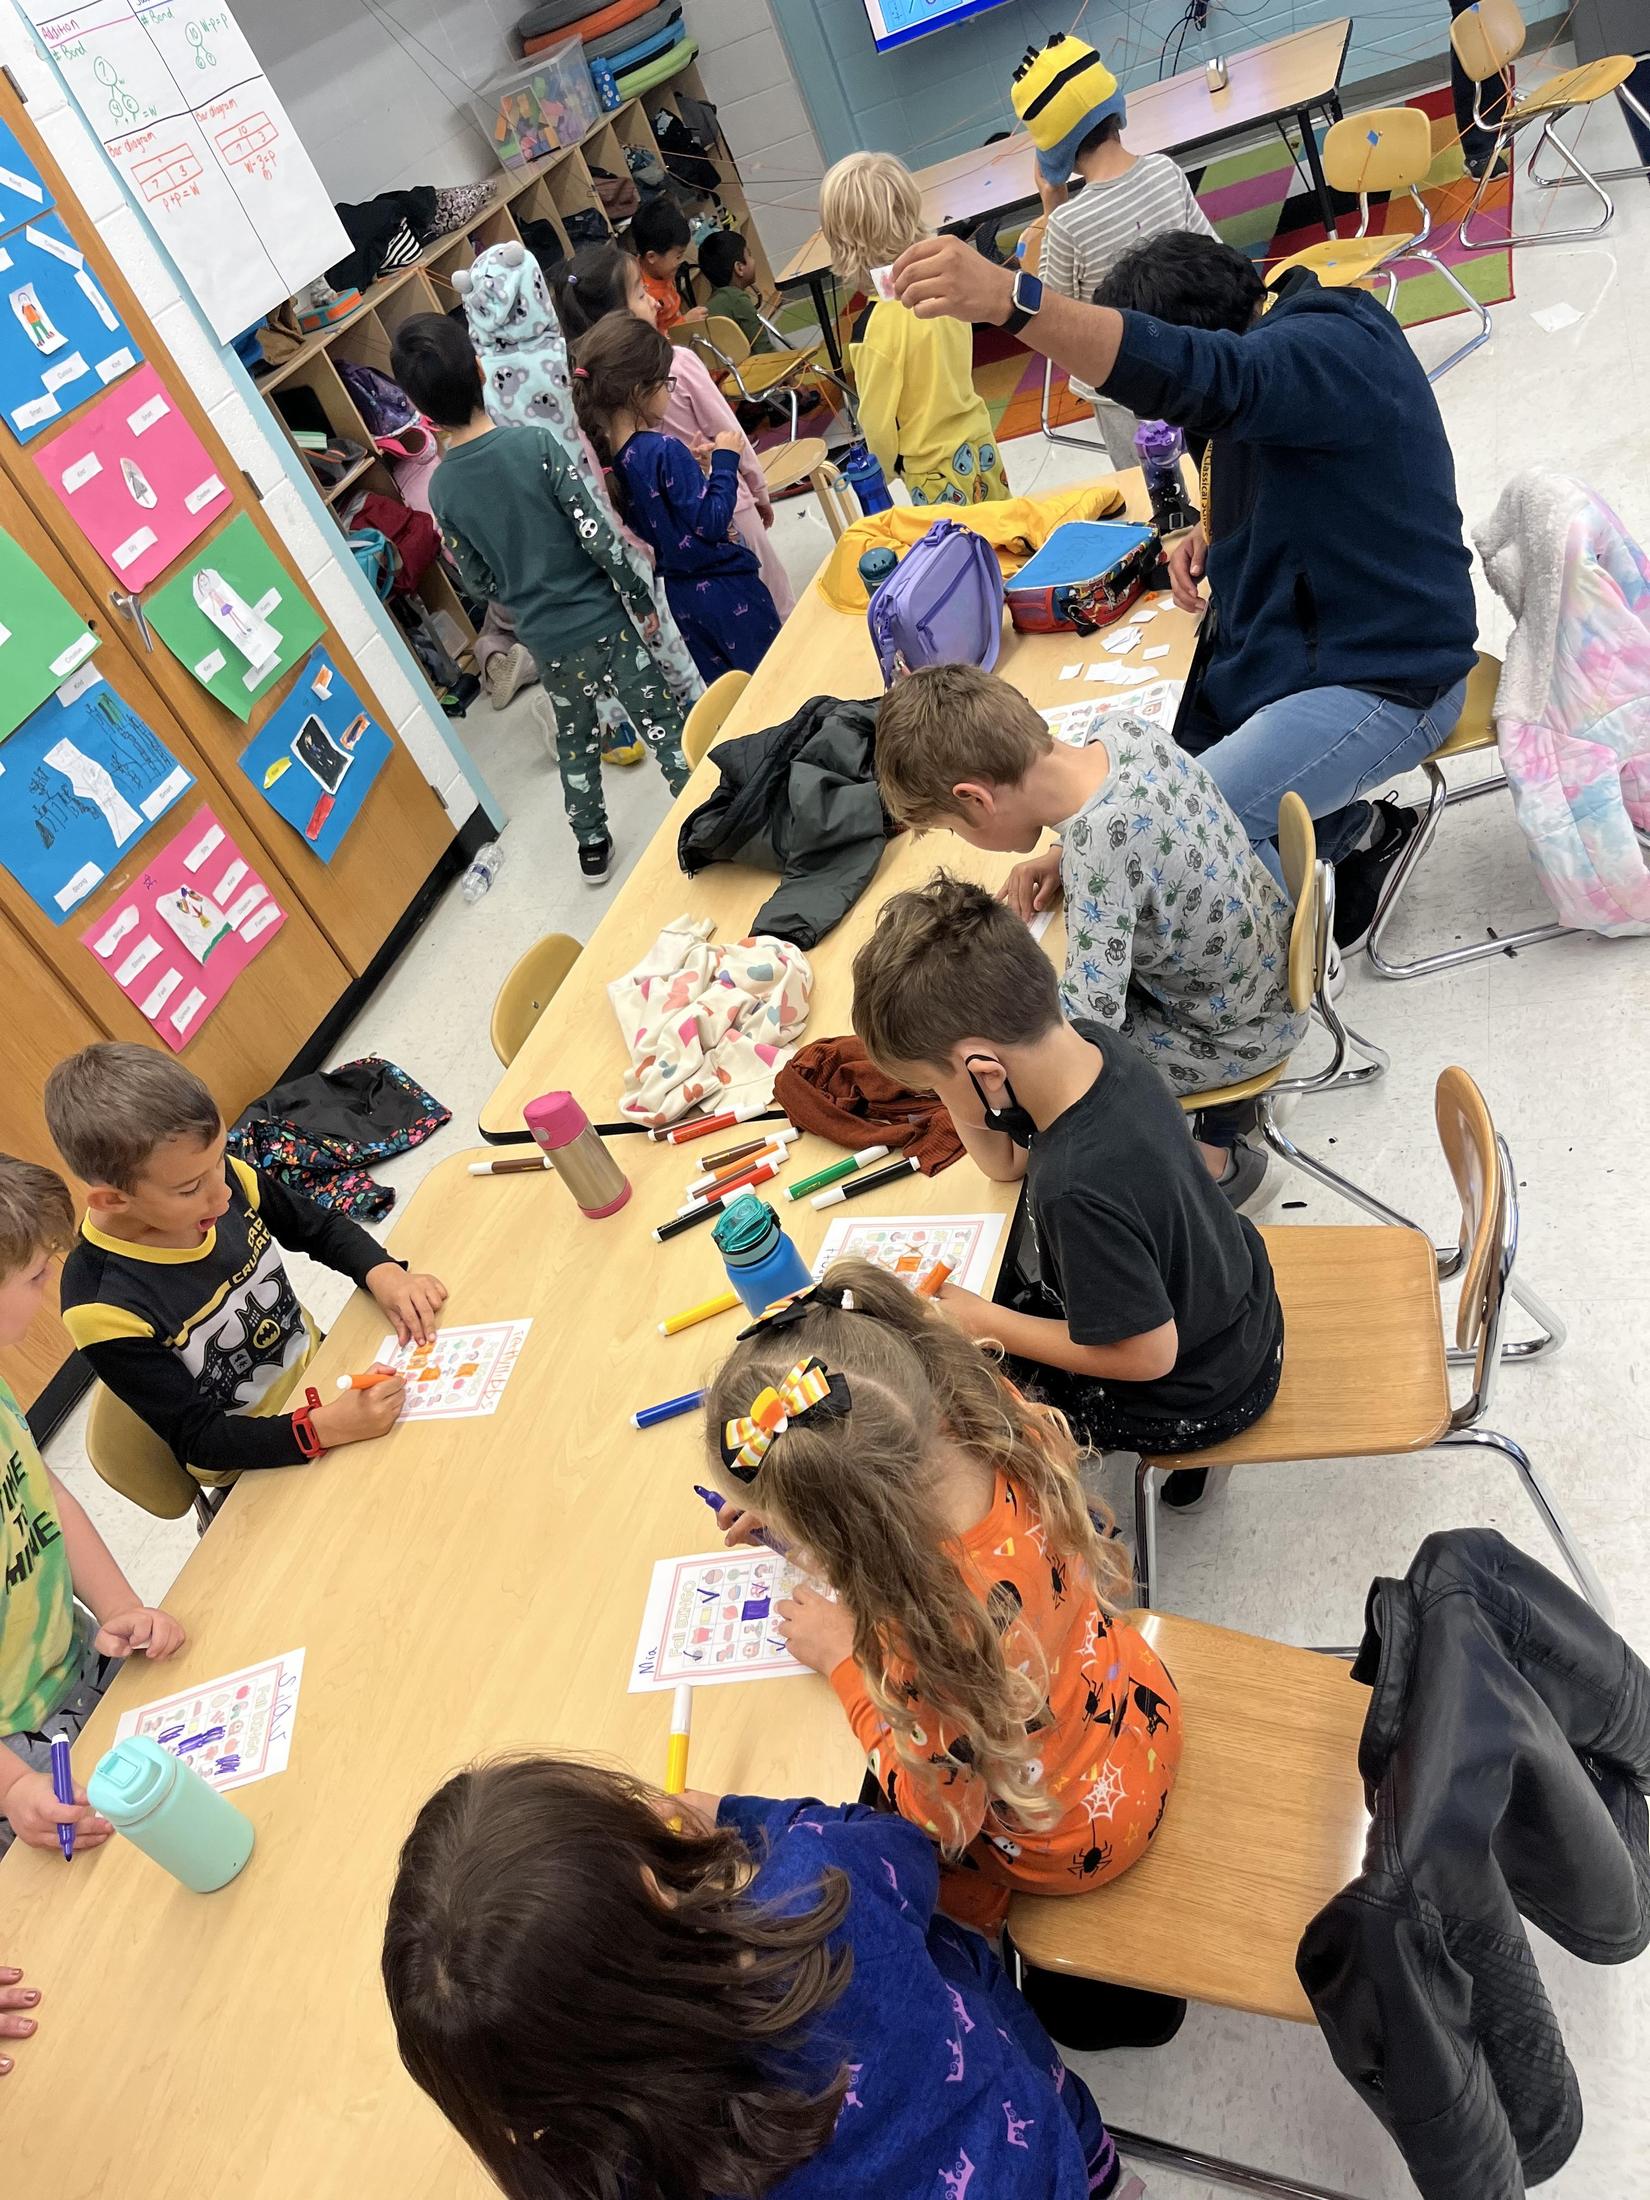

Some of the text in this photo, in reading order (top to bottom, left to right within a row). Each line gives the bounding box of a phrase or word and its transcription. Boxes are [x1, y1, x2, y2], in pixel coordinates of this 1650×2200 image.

[149, 8, 174, 24] Bond
[41, 19, 80, 40] Addition
[60, 40, 88, 60] Bond
[209, 98, 238, 119] diagram
[107, 131, 158, 158] Bar diagram
[247, 1220, 263, 1247] CAP
[669, 1580, 697, 1658] Fall BINGO
[638, 1646, 658, 1675] Mia
